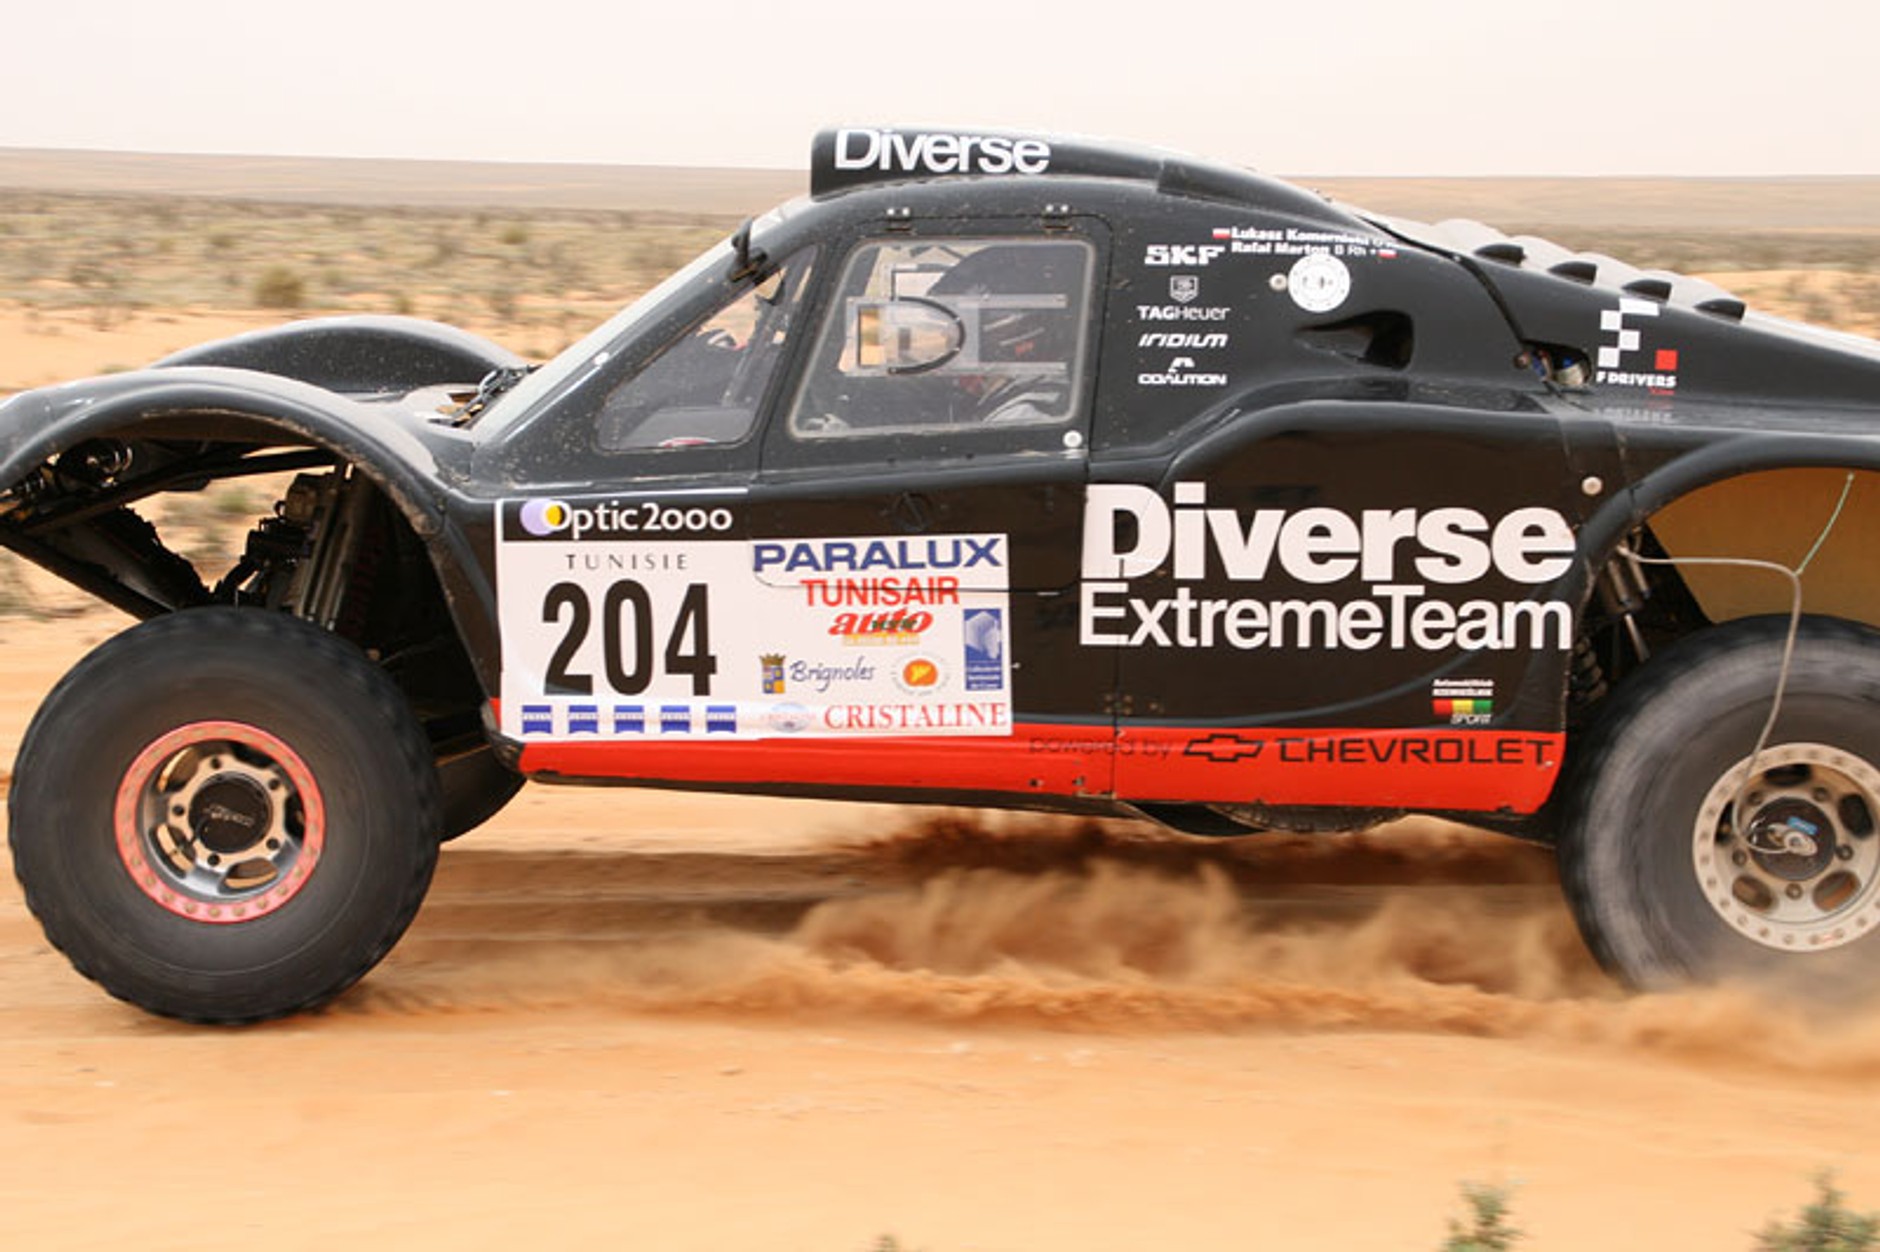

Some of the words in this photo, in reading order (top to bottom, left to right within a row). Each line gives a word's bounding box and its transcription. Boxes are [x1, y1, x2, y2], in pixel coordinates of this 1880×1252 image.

[834, 128, 1050, 175] Diverse
[1144, 246, 1226, 265] SKF
[1608, 373, 1677, 387] DRIVERS
[544, 500, 640, 541] Optic
[643, 502, 733, 532] 2000
[1081, 481, 1577, 584] Diverse
[566, 553, 689, 571] TUNISIE
[753, 538, 1003, 572] PARALUX
[801, 577, 960, 607] TUNISAIR
[828, 608, 934, 636] auto
[1080, 582, 1573, 651] ExtremeTeam
[541, 579, 717, 697] 204
[789, 655, 877, 693] Brignoles
[824, 702, 1008, 729] CRISTALINE
[1029, 737, 1133, 756] powered
[1143, 739, 1171, 759] by
[1277, 738, 1556, 764] CHEVROLET
